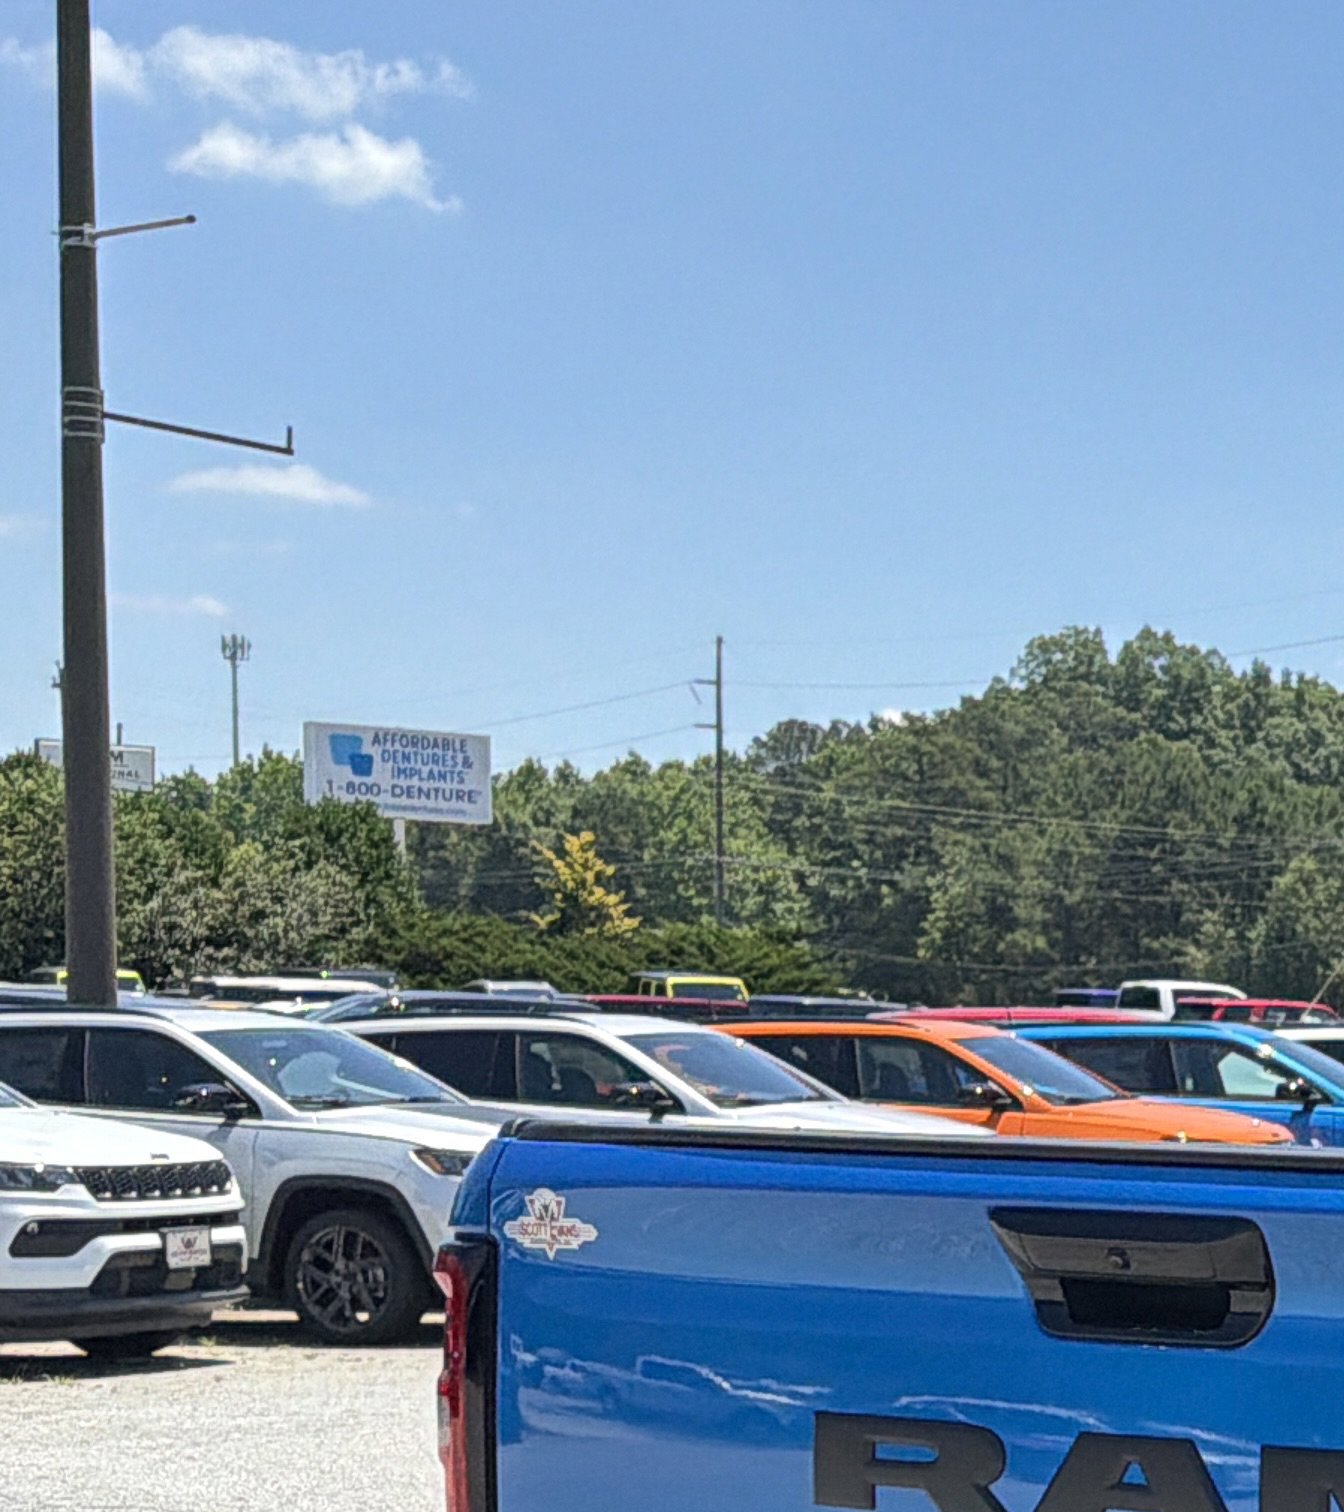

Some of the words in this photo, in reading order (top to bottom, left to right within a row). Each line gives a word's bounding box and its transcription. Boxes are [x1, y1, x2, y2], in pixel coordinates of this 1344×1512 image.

[371, 731, 468, 754] AFFORDABLE
[380, 748, 460, 769] DENTURES
[461, 755, 474, 770] &
[391, 764, 466, 785] IMPLANTS
[326, 779, 479, 804] 1-800-DENTURE
